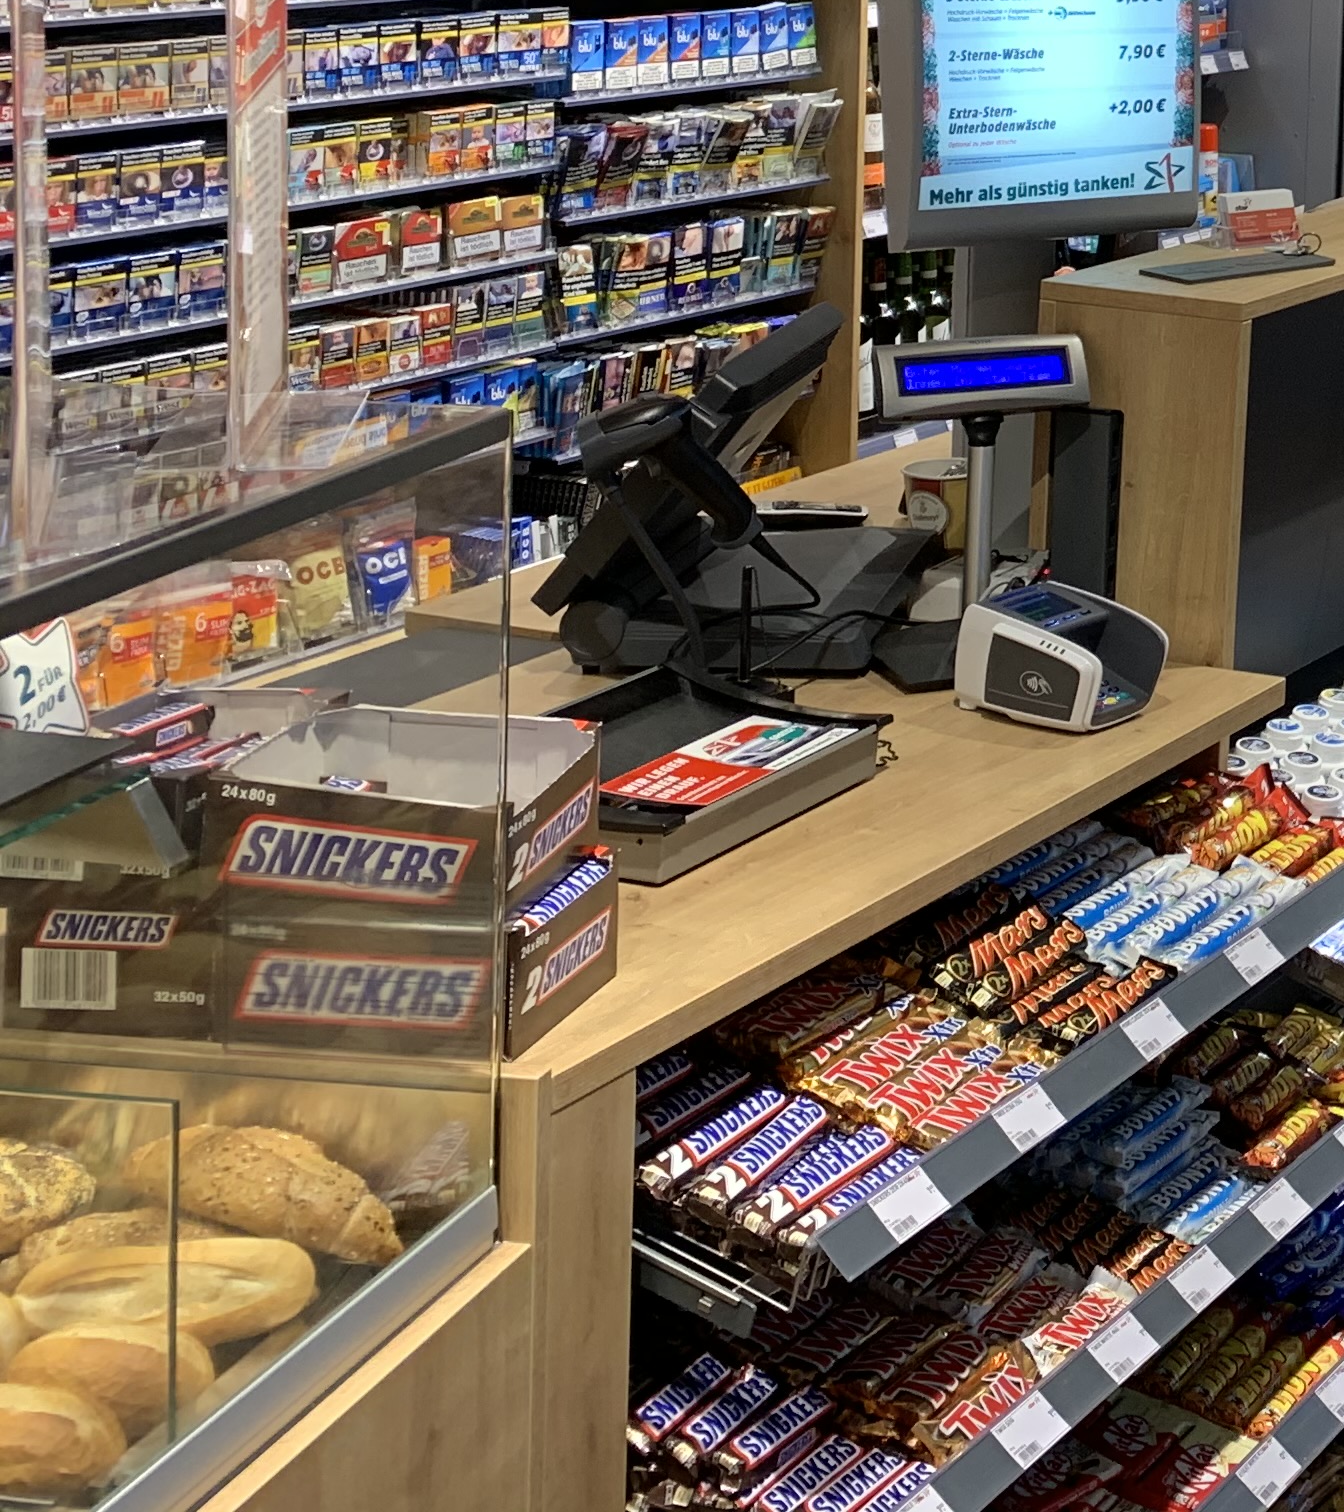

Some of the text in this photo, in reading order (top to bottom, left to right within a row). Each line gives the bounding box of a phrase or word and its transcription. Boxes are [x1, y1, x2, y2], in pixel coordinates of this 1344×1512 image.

[578, 40, 592, 52] blu
[613, 38, 627, 50] blu
[792, 20, 805, 32] blu
[949, 44, 1166, 62] 2-Sterne-Wäsche 7,90 €
[949, 106, 1017, 119] Extra-Stern-
[949, 98, 1166, 134] Unterbodenwäsche +2,00 €
[930, 174, 1134, 205] Mehr als günstig tanken!
[522, 526, 530, 560] OCB
[296, 556, 345, 585] OCB
[194, 613, 207, 632] 6
[110, 635, 124, 653] 6
[14, 665, 62, 705] 2 FÜR
[57, 685, 67, 702] €
[637, 775, 681, 797] EINEN
[647, 757, 690, 779] LEGEN
[222, 784, 276, 807] 24x80g
[507, 789, 592, 891] 2 SNICKERS
[508, 807, 537, 838] 24x80g
[239, 825, 459, 894] SNICKERS
[536, 859, 609, 923] SNICKERS
[45, 911, 174, 945] SNICKERS
[1087, 893, 1161, 940] BOUNTY
[1142, 888, 1217, 941] BOUNTY
[1182, 902, 1250, 956] BOUNTY
[520, 931, 550, 960] 24x80g
[970, 905, 1047, 978] Mars
[1004, 919, 1084, 999] Mars
[520, 918, 608, 1015] 2 SNICKERS
[153, 989, 205, 1008] 32x50g
[252, 961, 474, 1018] SNICKERS
[665, 1084, 784, 1179] 2 SNICKERS
[1112, 1088, 1182, 1140] BOUNTY
[714, 1098, 824, 1199] 2 SNICKERS
[760, 1125, 888, 1222] 2 SNICKERS
[831, 1146, 922, 1213] SNICKERS
[1150, 1151, 1220, 1208] BOUNTY
[690, 1369, 778, 1449] SNICKERS
[738, 1388, 829, 1460] SNICKERS
[762, 1437, 858, 1512] SNICKERS
